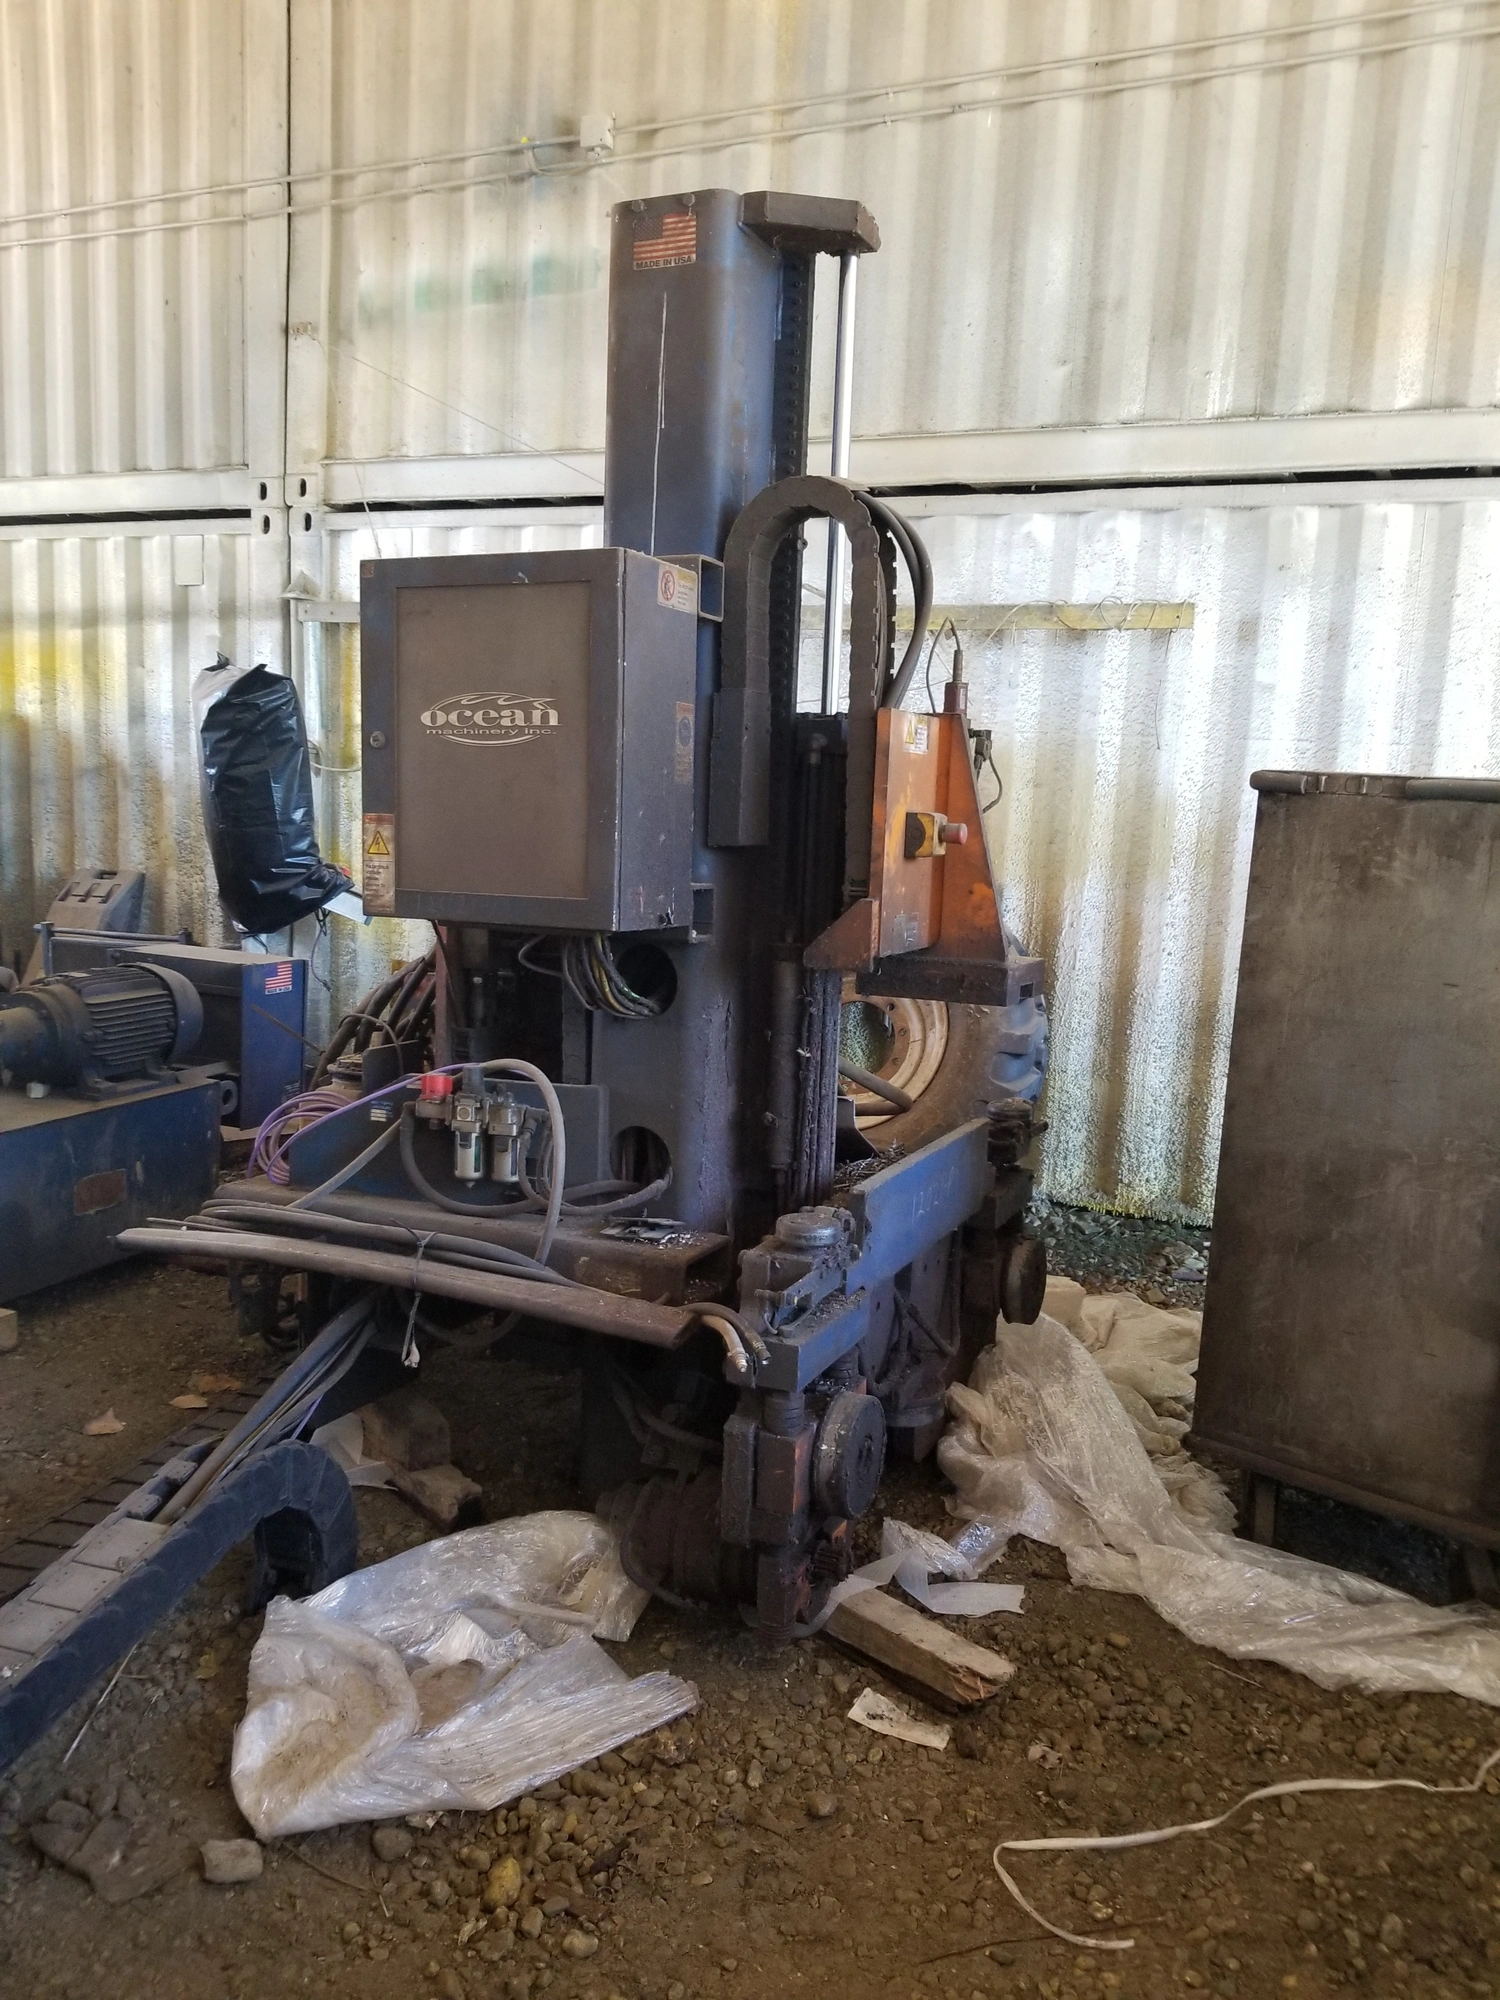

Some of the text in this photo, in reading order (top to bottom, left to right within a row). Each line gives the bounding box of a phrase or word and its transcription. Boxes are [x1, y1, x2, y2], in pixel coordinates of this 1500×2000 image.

[636, 256, 692, 269] MADE IN USA
[420, 709, 563, 727] ocean
[426, 727, 557, 736] machinery inc.
